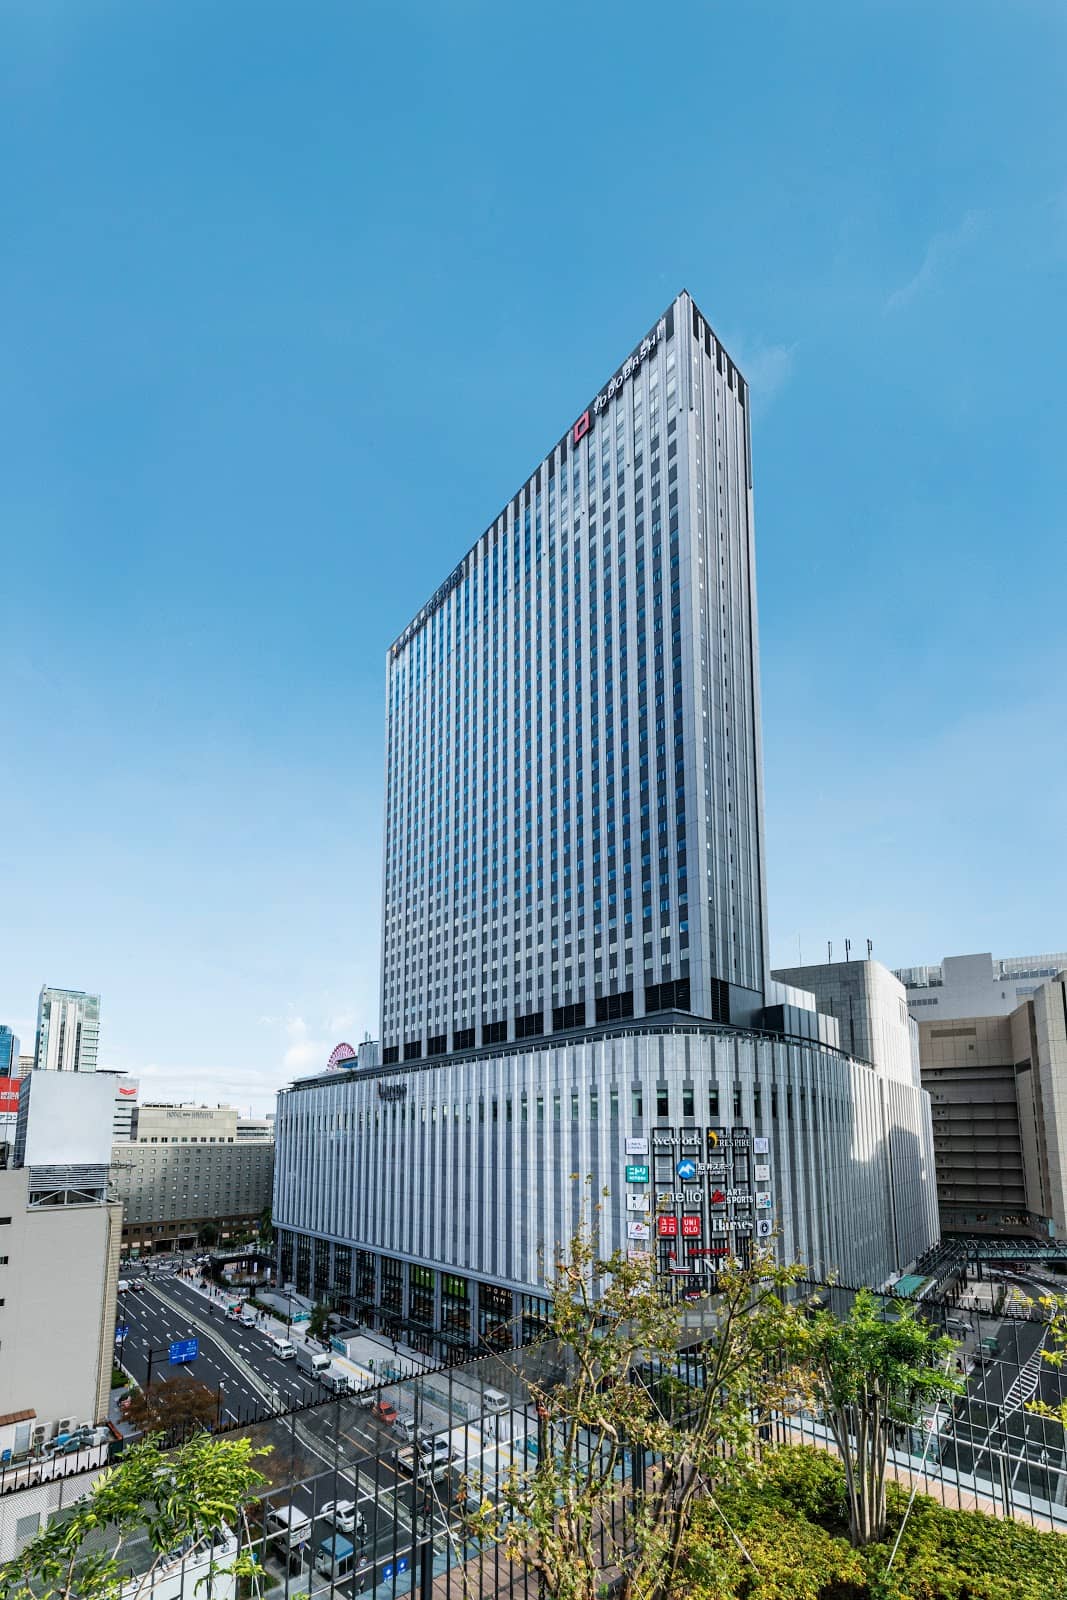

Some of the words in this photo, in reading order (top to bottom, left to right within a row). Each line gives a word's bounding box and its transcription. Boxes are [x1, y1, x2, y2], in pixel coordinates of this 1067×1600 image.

[629, 1167, 646, 1175] ニトリ
[726, 1195, 753, 1204] SPORTS
